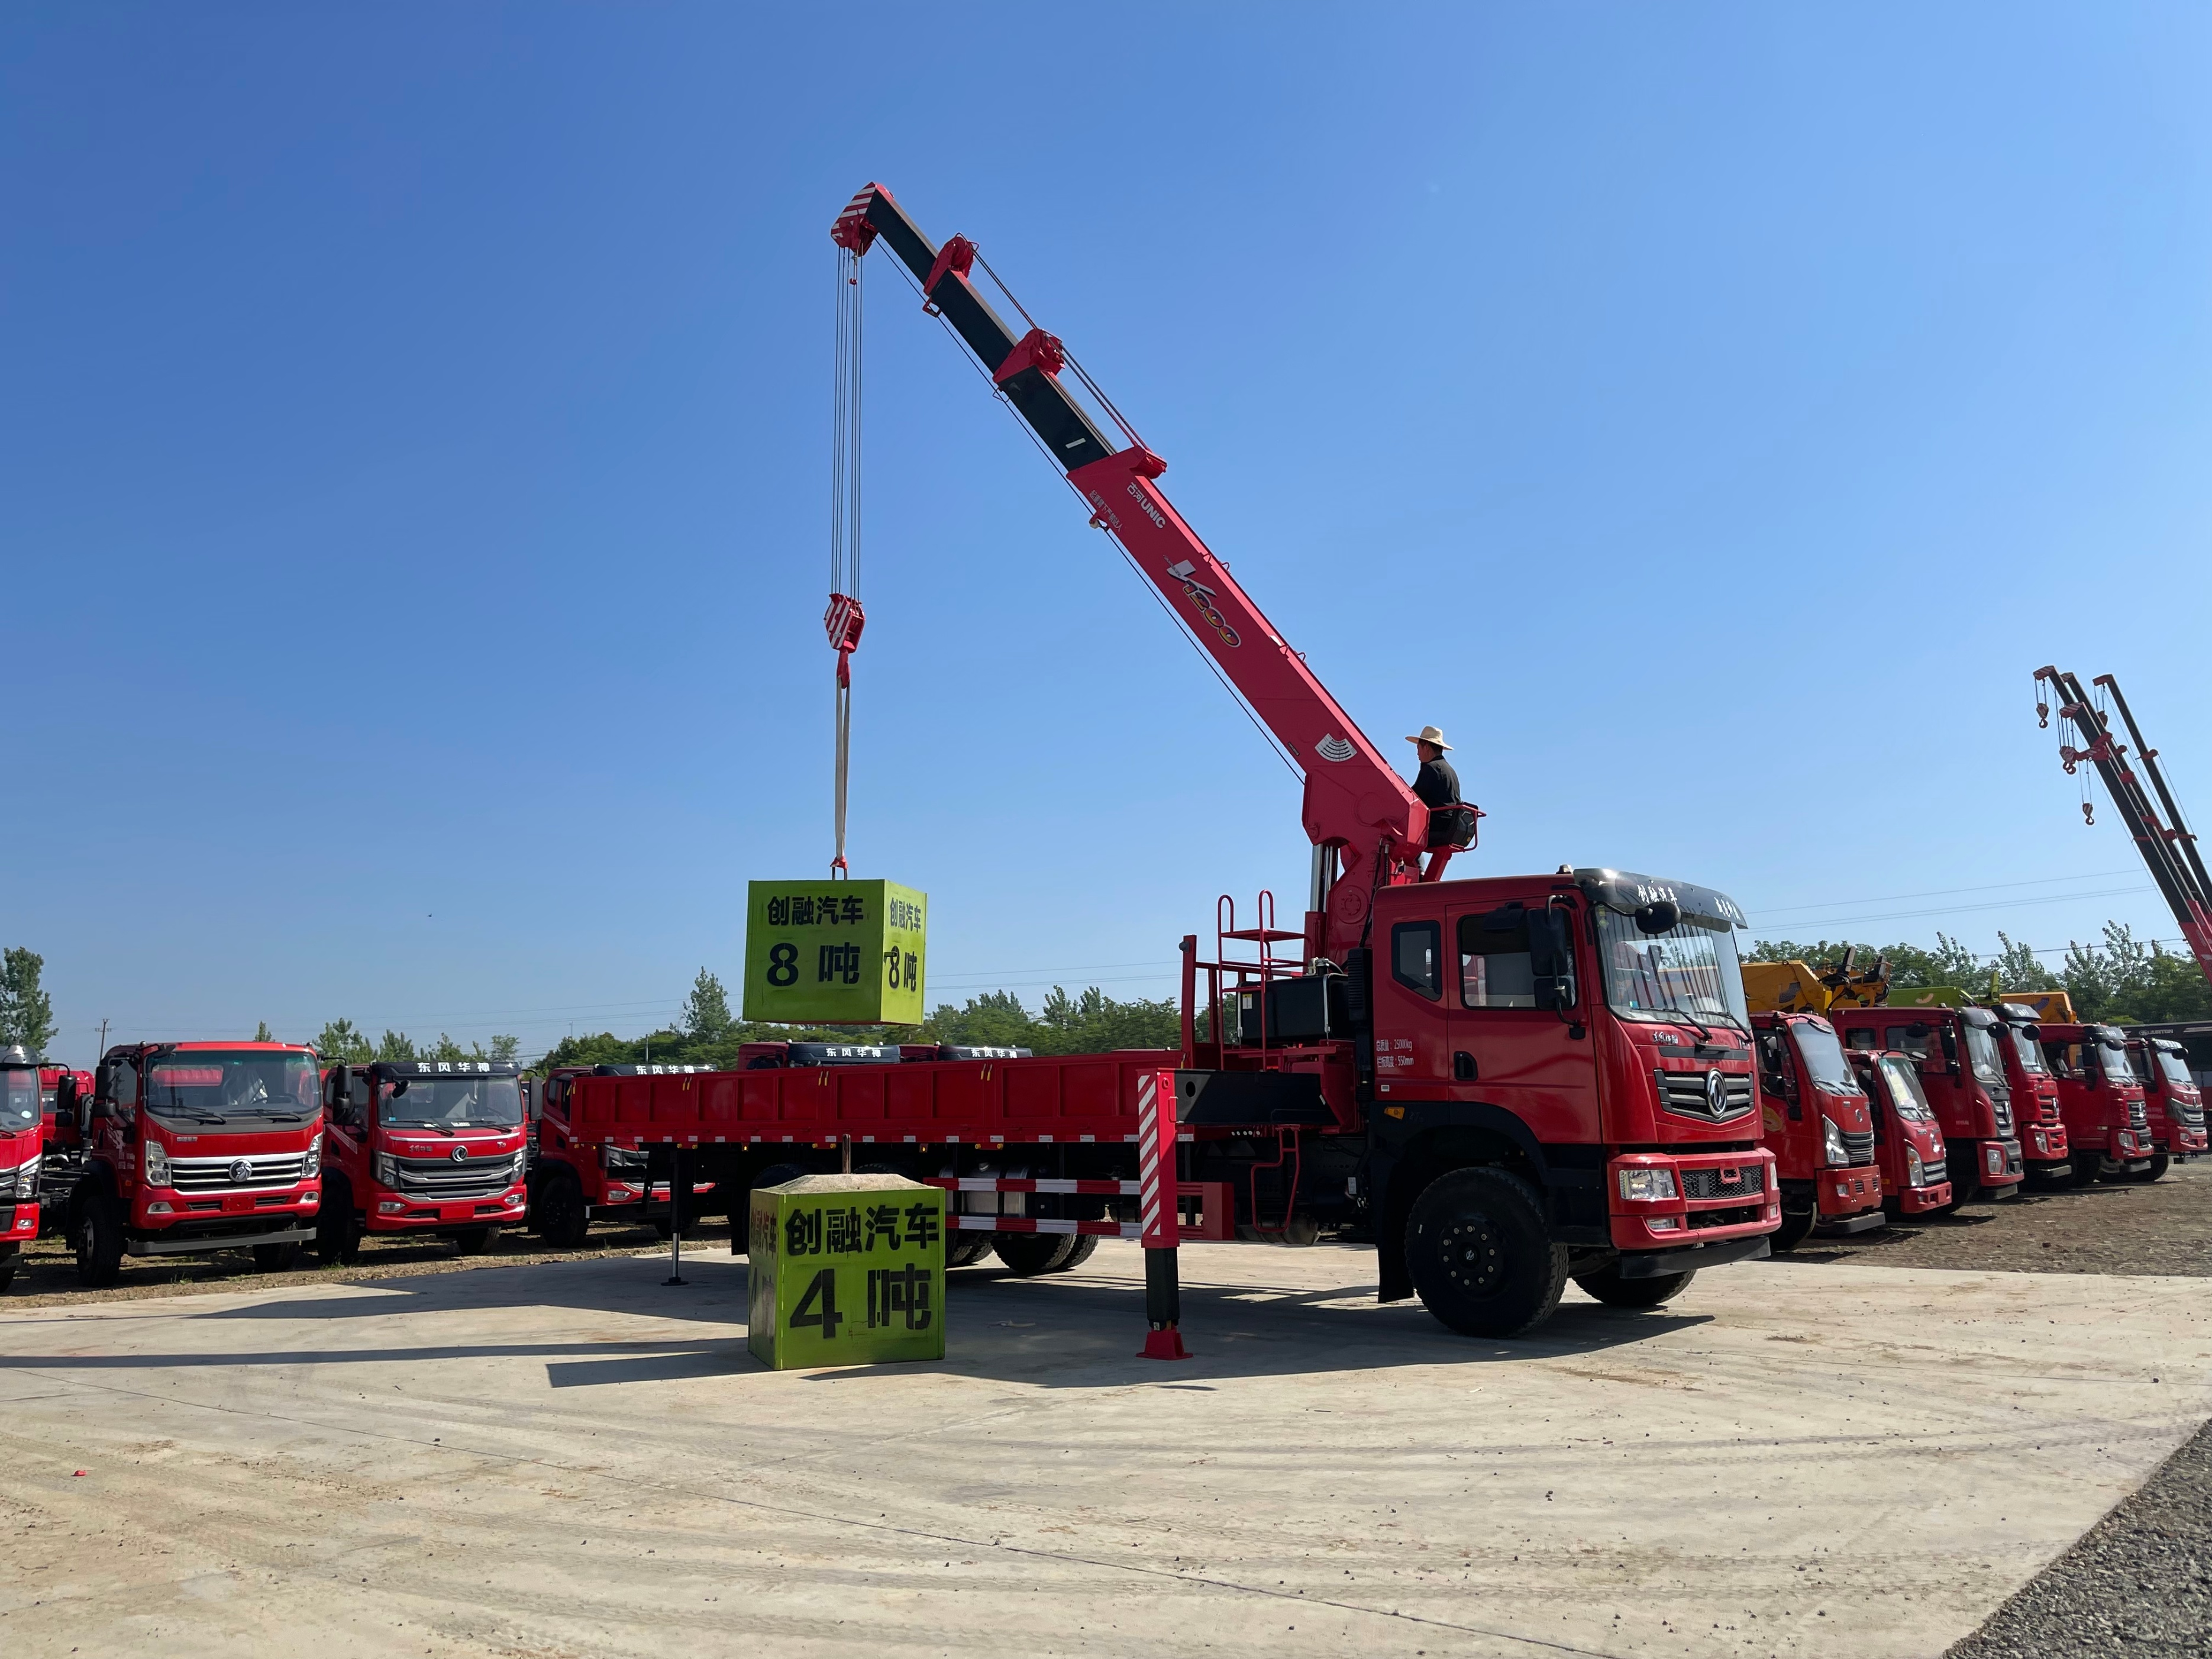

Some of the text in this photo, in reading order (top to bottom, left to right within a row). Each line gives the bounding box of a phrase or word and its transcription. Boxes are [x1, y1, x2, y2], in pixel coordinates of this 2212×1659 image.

[767, 895, 864, 926] 创融汽车
[890, 897, 921, 933] 创融汽车
[767, 942, 861, 986] 8 吨
[889, 945, 917, 992] 8 吨
[417, 1062, 490, 1073] 东风华神
[826, 1048, 881, 1058] 东风华神
[971, 1048, 1018, 1058] 东风华神
[786, 1203, 939, 1256] 创融汽车
[790, 1268, 843, 1339] 4
[868, 1263, 932, 1330] 吨
